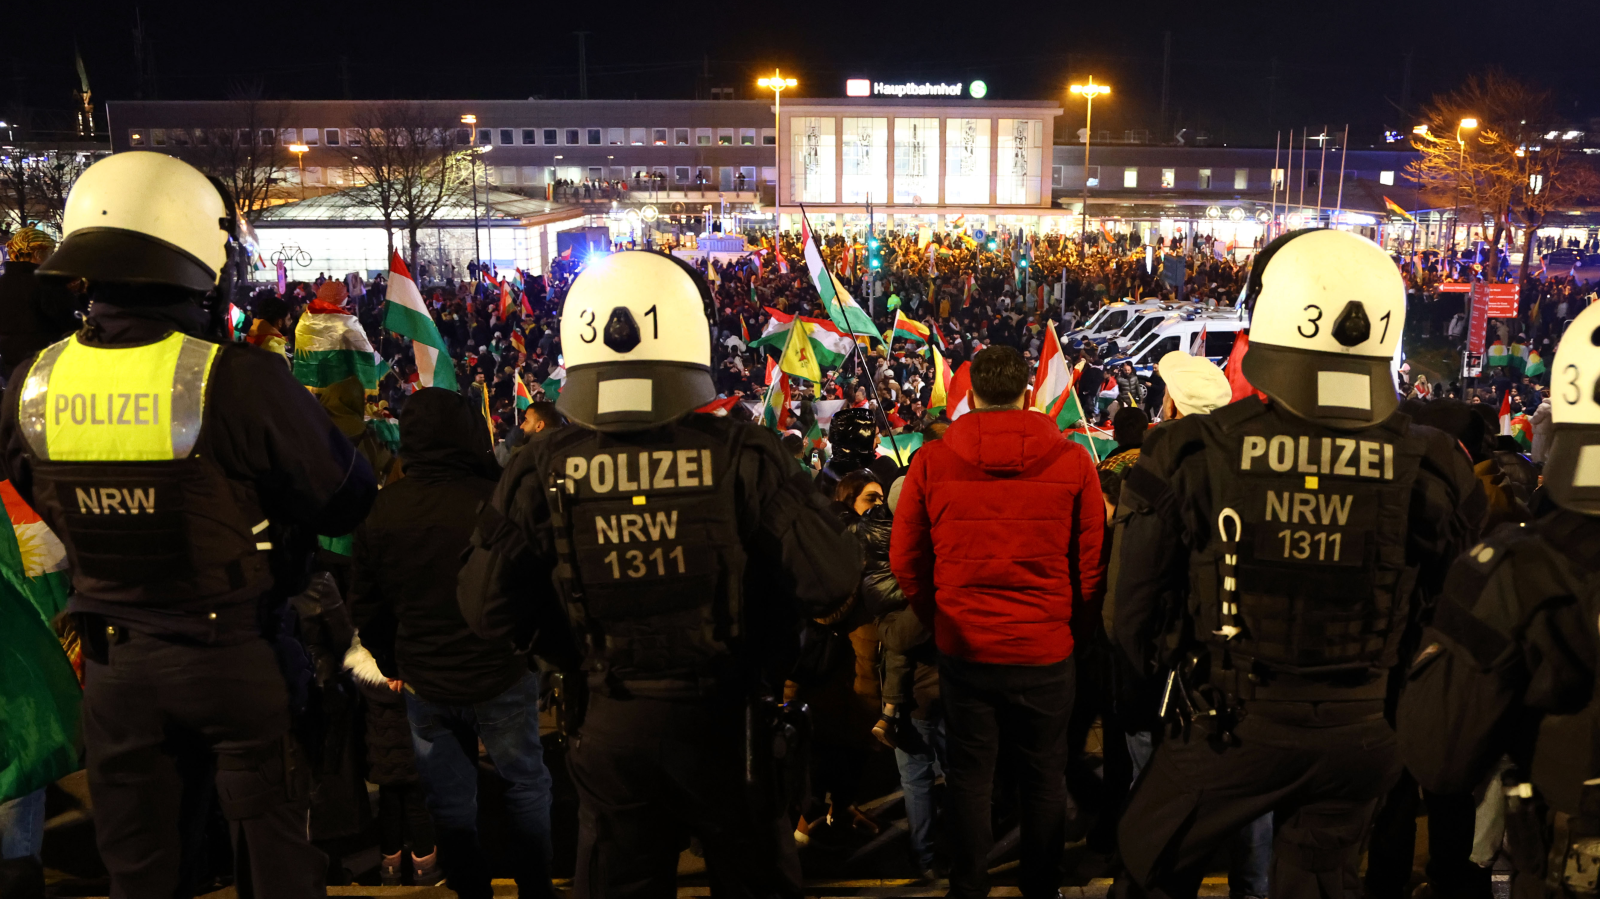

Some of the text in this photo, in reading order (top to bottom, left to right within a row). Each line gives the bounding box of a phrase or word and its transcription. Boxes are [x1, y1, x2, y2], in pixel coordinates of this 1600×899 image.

[873, 82, 962, 97] Hauptbahnhof
[580, 304, 658, 344] 3 1
[1297, 304, 1391, 345] 3 1
[1562, 364, 1581, 405] 3
[54, 393, 159, 425] POLIZEI
[565, 449, 713, 494] POLIZEI
[1241, 434, 1394, 480] POLIZEI
[75, 487, 155, 514] NRW
[1265, 490, 1354, 526] NRW
[595, 510, 678, 544] NRW
[604, 545, 686, 579] 1311
[1278, 529, 1342, 562] 1311
